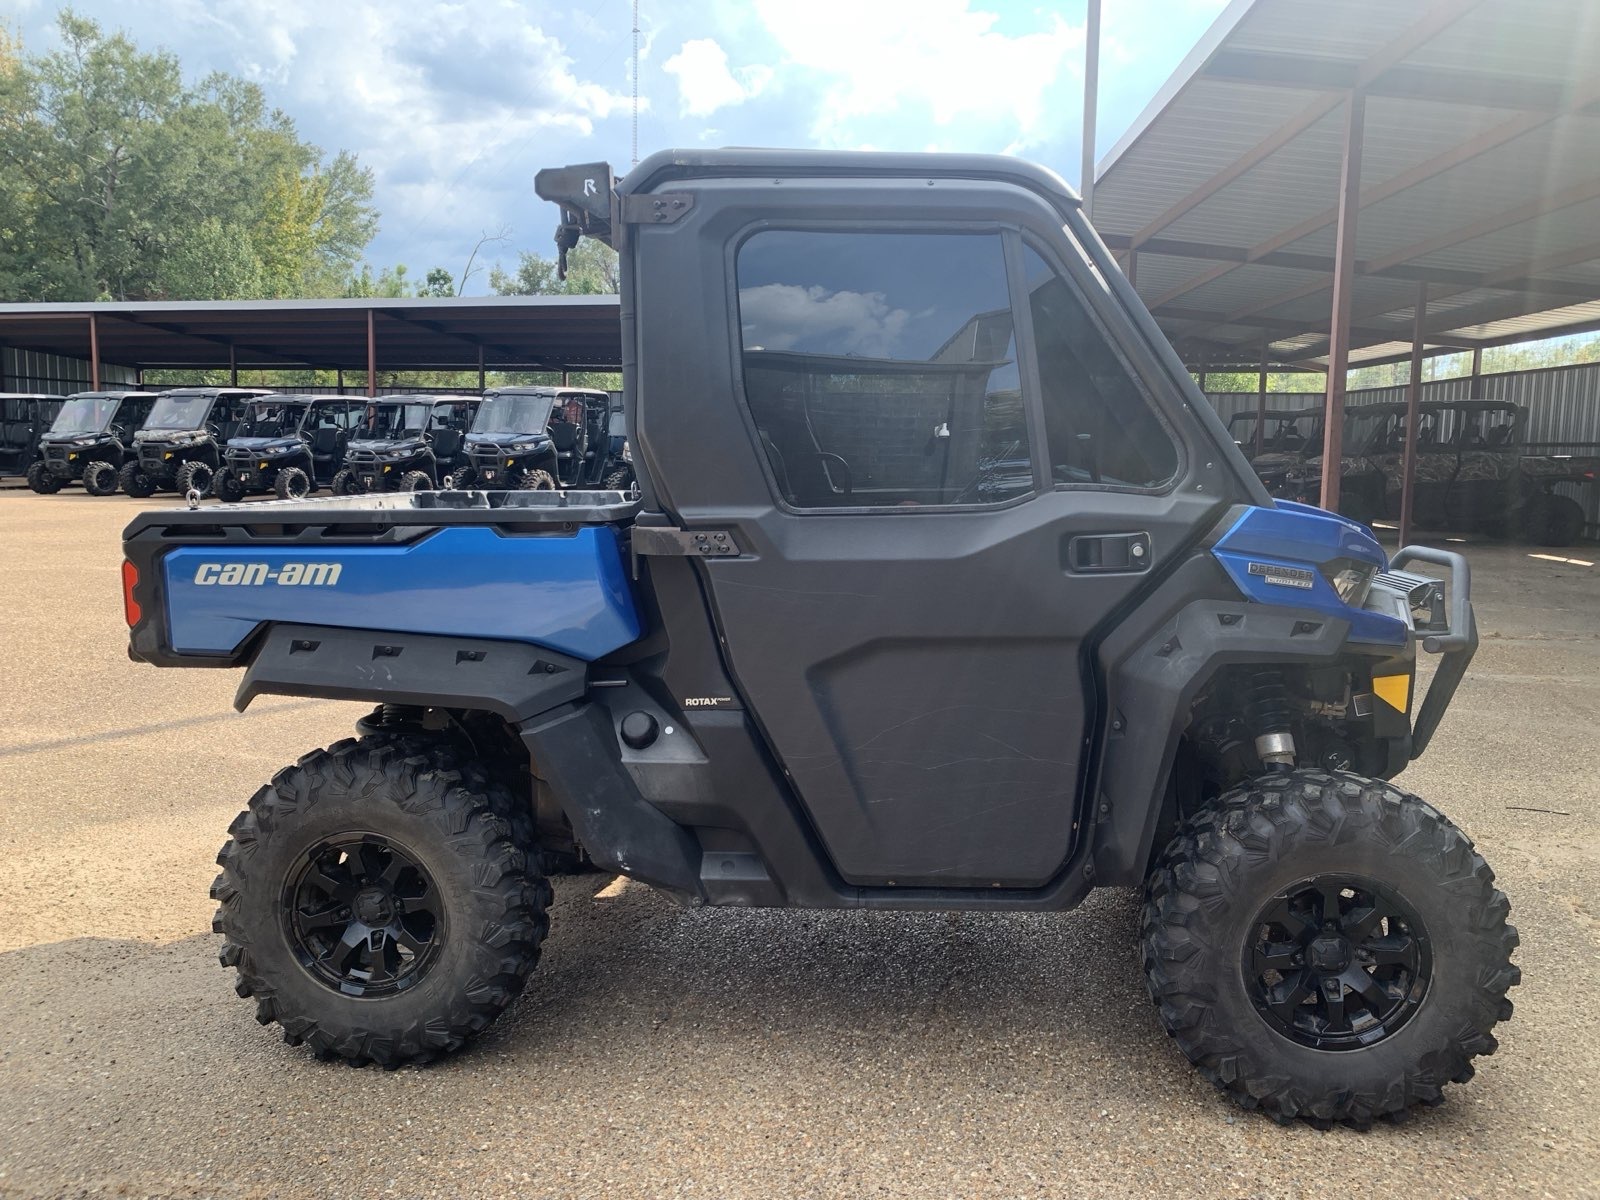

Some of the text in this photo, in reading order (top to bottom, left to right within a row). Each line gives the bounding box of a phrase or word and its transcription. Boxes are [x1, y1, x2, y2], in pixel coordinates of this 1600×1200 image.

[194, 563, 343, 586] can-am
[1250, 564, 1313, 581] DEFENDER
[685, 697, 718, 706] ROTAX
